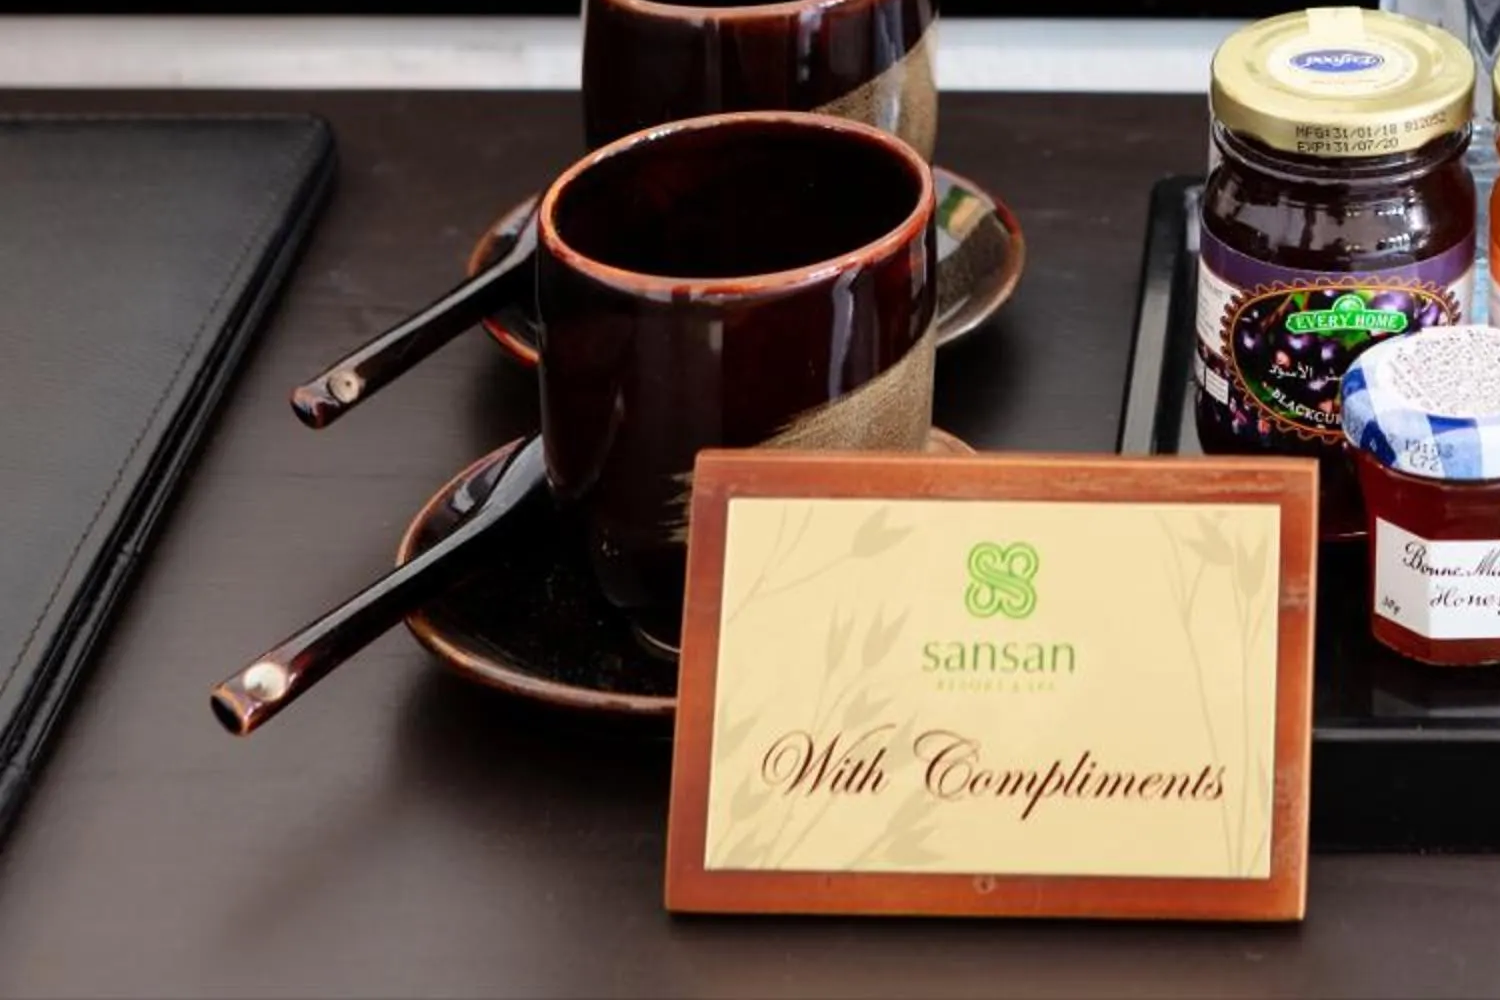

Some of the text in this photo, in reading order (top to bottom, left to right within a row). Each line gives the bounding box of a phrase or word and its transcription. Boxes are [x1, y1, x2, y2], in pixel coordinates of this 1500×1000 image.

[1296, 313, 1399, 330] EVERY HOME
[922, 640, 1076, 673] sansan
[760, 723, 1226, 820] With Compliments
